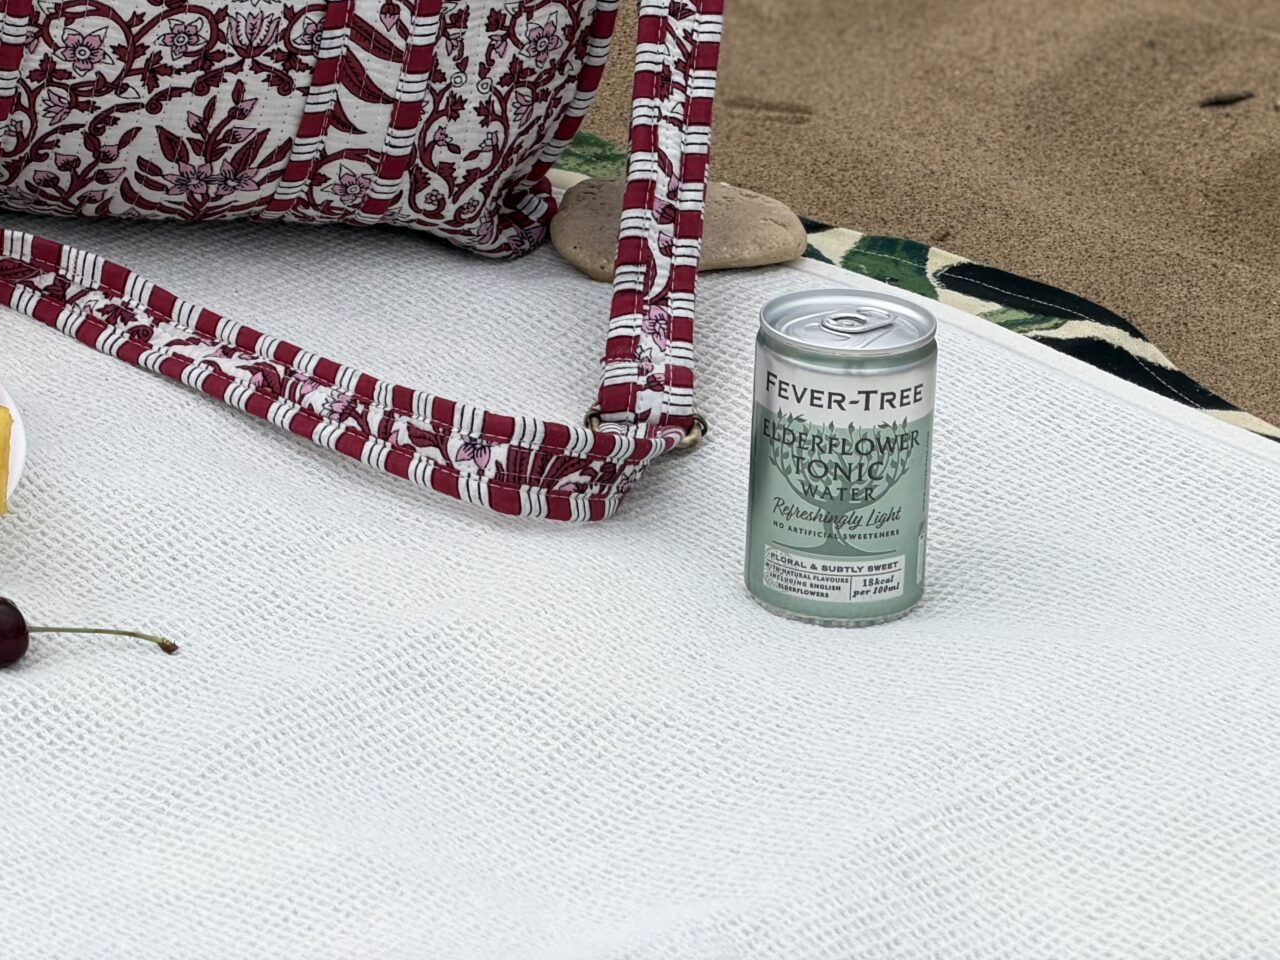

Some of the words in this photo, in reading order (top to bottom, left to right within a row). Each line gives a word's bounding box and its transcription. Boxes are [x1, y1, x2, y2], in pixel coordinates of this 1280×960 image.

[766, 370, 924, 411] FEVER-TREE
[763, 418, 920, 456] ELDERFLOWER
[792, 455, 884, 482] TONIC
[800, 481, 876, 501] WATER
[773, 496, 863, 530] Refreshingly
[866, 506, 902, 529] Light
[773, 520, 784, 529] NO
[787, 525, 839, 539] ARTIFICIAL
[843, 529, 900, 540] SWEETENERS
[770, 552, 807, 569] FLORAL
[810, 563, 818, 571] &
[821, 565, 864, 573] SUBTLY
[867, 560, 899, 573] SWEET
[770, 572, 807, 587] INCLUDING
[809, 583, 841, 591] ENGLISH
[781, 567, 811, 580] NATURAL
[813, 575, 849, 584] FLAVOURS
[778, 582, 829, 598] ELDERFLOWERS
[852, 589, 871, 598] per
[872, 582, 900, 595] 100ml
